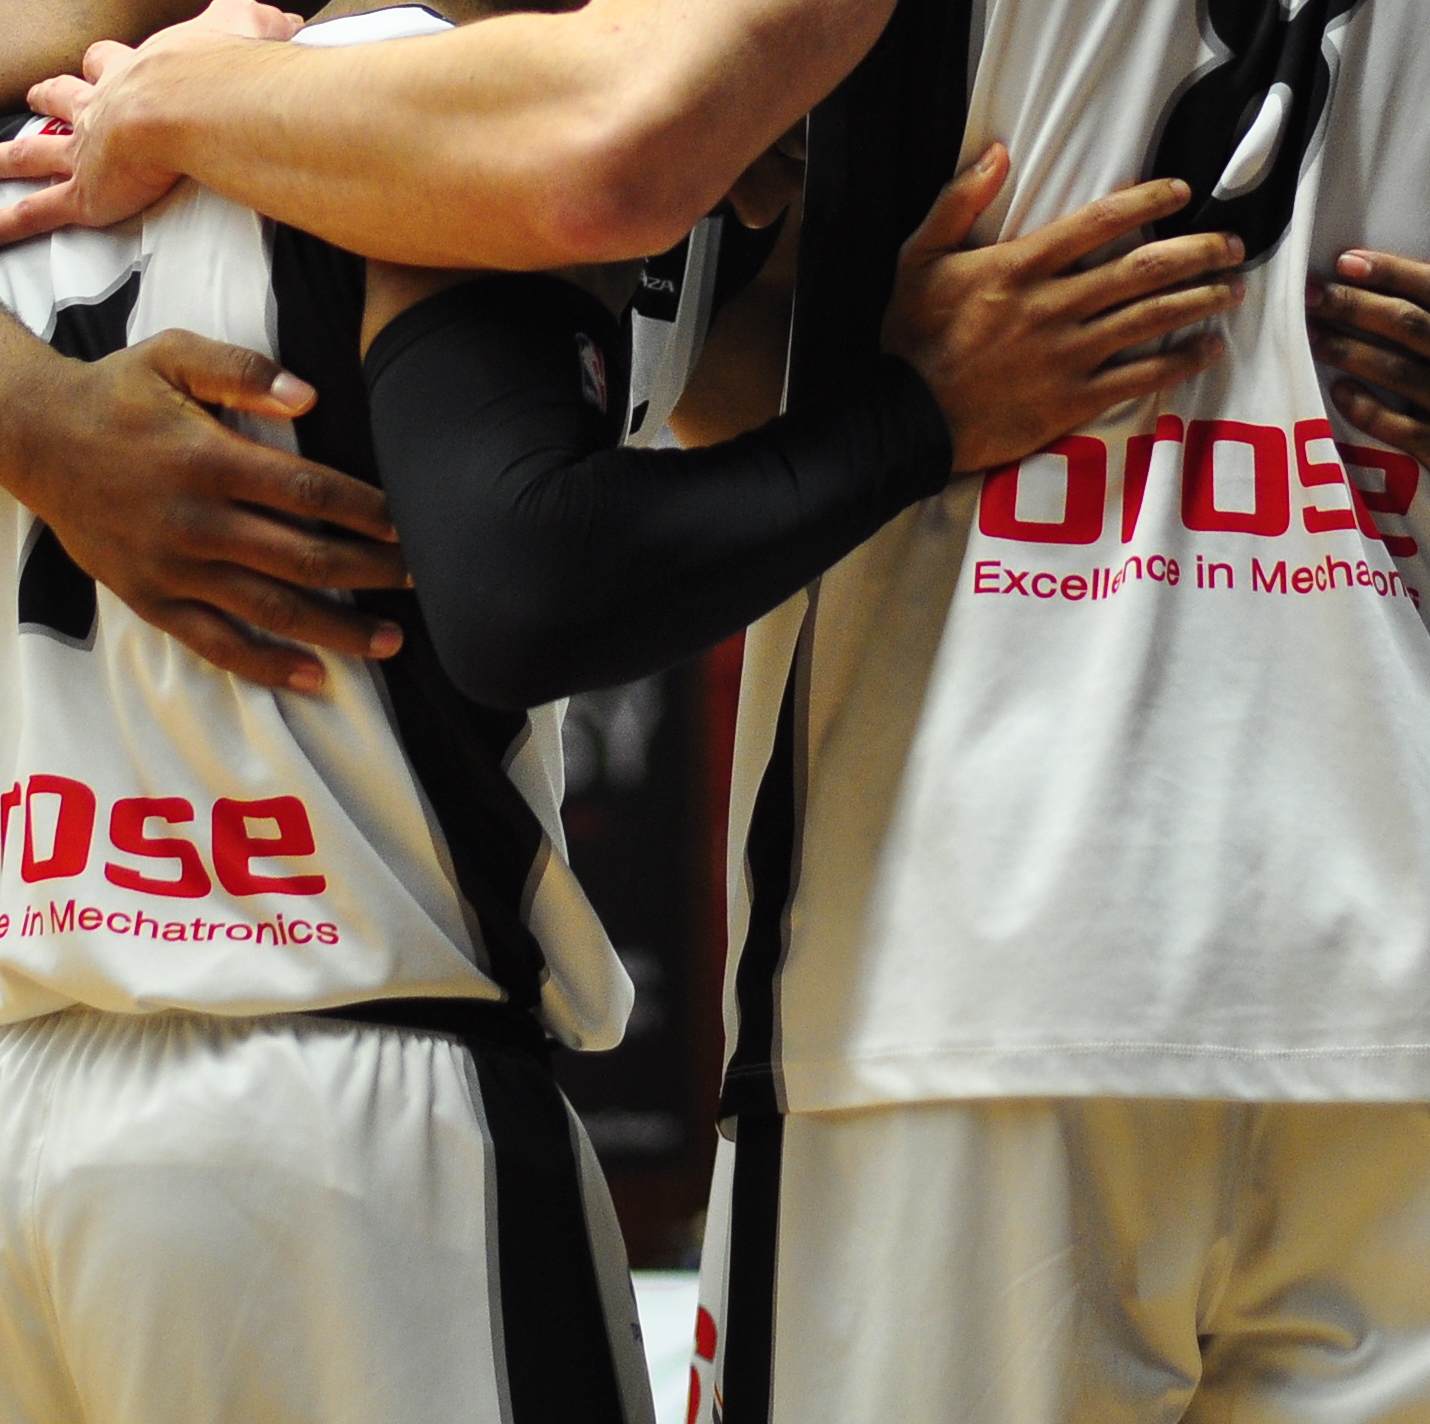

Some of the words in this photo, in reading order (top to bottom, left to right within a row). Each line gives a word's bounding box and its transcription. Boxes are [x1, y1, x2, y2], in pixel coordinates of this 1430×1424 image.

[1195, 554, 1234, 589] in
[20, 904, 44, 937] in
[49, 898, 340, 947] Mechatronics
